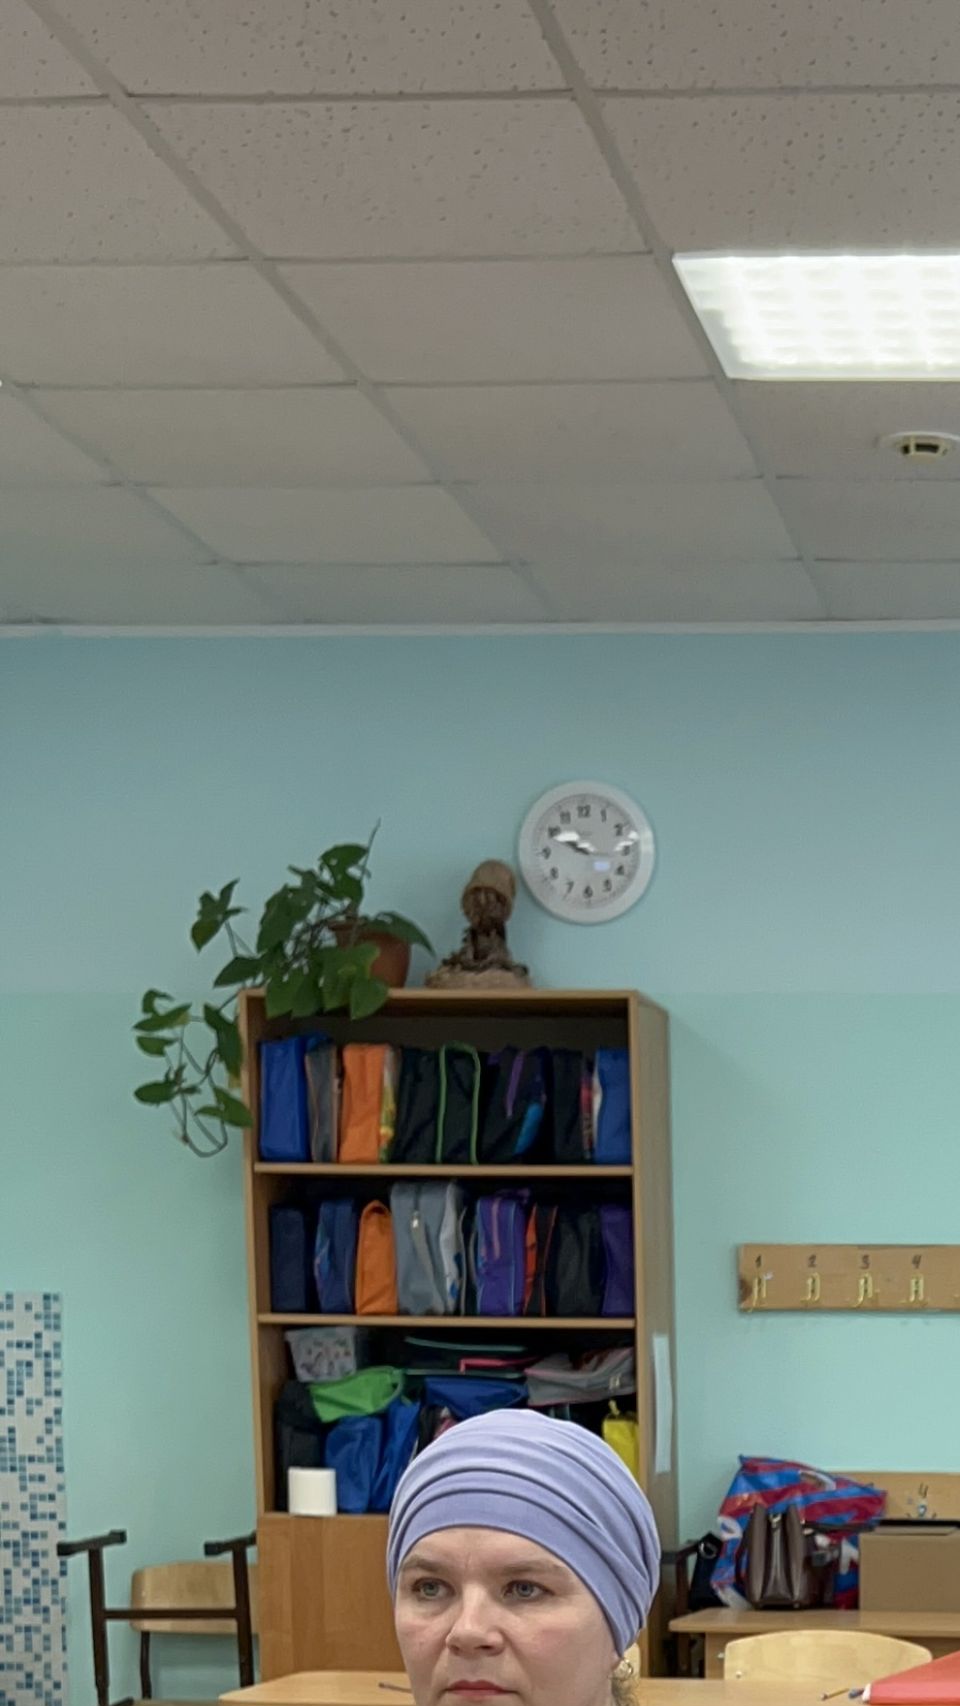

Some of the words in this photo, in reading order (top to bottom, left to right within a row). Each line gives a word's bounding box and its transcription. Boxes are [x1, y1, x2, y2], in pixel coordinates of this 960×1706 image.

[577, 805, 591, 818] 12
[807, 1254, 817, 1269] 2
[860, 1254, 871, 1269] 3
[912, 1254, 922, 1269] 4
[918, 1482, 929, 1498] 4
